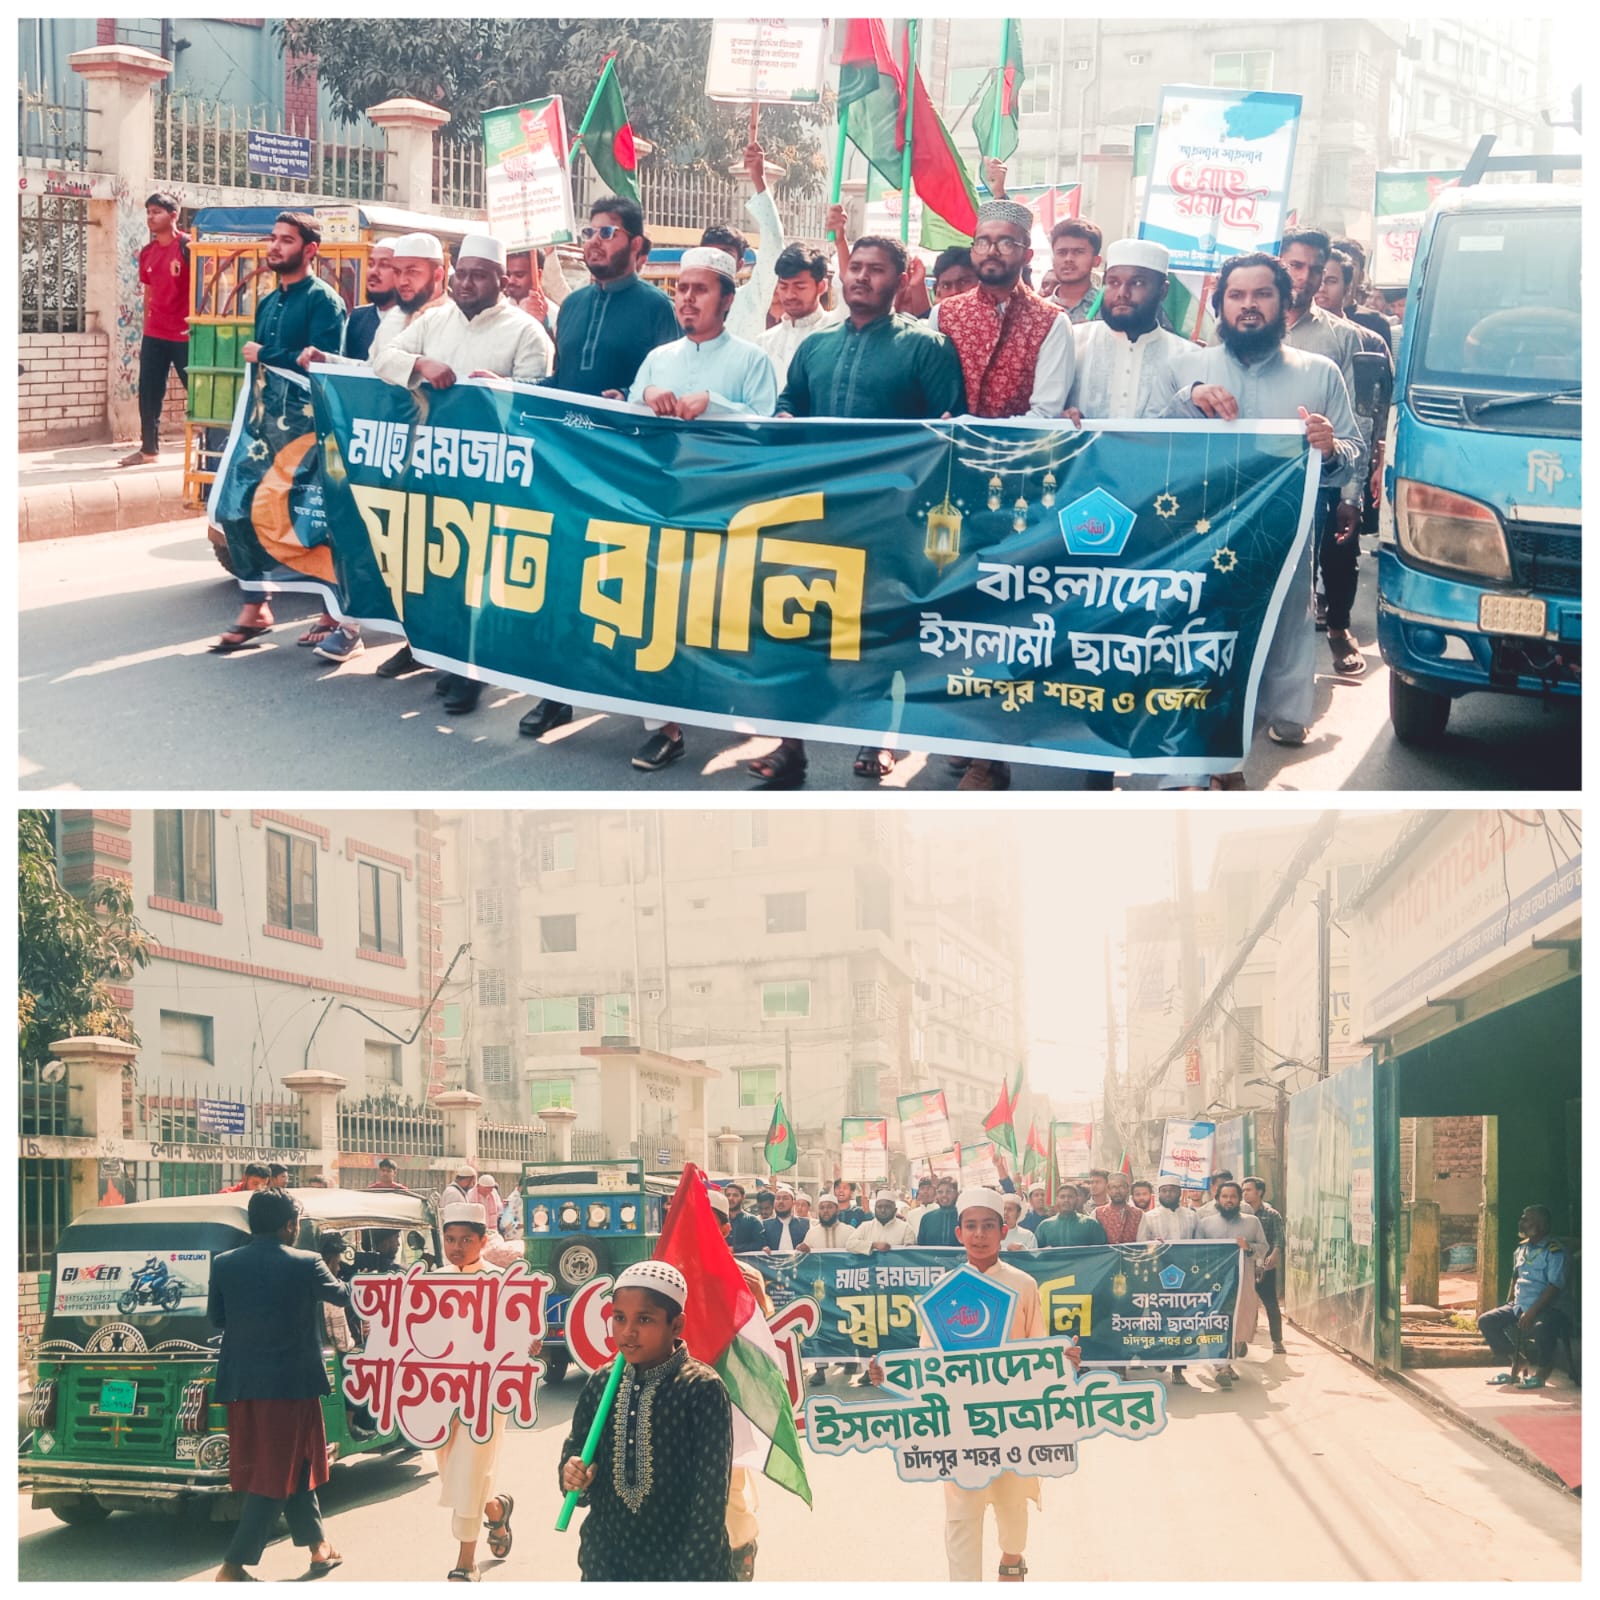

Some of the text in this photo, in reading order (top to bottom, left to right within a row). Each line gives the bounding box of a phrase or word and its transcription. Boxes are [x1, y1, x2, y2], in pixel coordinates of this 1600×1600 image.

[349, 418, 536, 488] মাহে রমজান
[977, 561, 1207, 616] বাংলাদেশ
[919, 612, 1240, 678] ইসলামী ছাত্রশিবির
[946, 667, 1212, 716] চাঁদপুর শহর ও জেলা
[177, 1254, 206, 1262] SUZUKI
[836, 1266, 945, 1292] মাহে রমজান
[353, 1264, 549, 1360] আহলান
[836, 1295, 922, 1350] স্বাগ
[1111, 1311, 1230, 1332] ইসলামী ছাত্রশিবির
[1131, 1292, 1213, 1309] বাংলাদেশ
[1122, 1334, 1224, 1350] চাঁদপুর শহর ও জেলা
[884, 1346, 1067, 1392] বাংলাদেশ
[346, 1349, 541, 1445] সাহলান
[814, 1384, 1156, 1447] ইসলামী ছাত্রশিবির
[903, 1443, 1076, 1477] চাঁদপুর শহর ও জেলা
